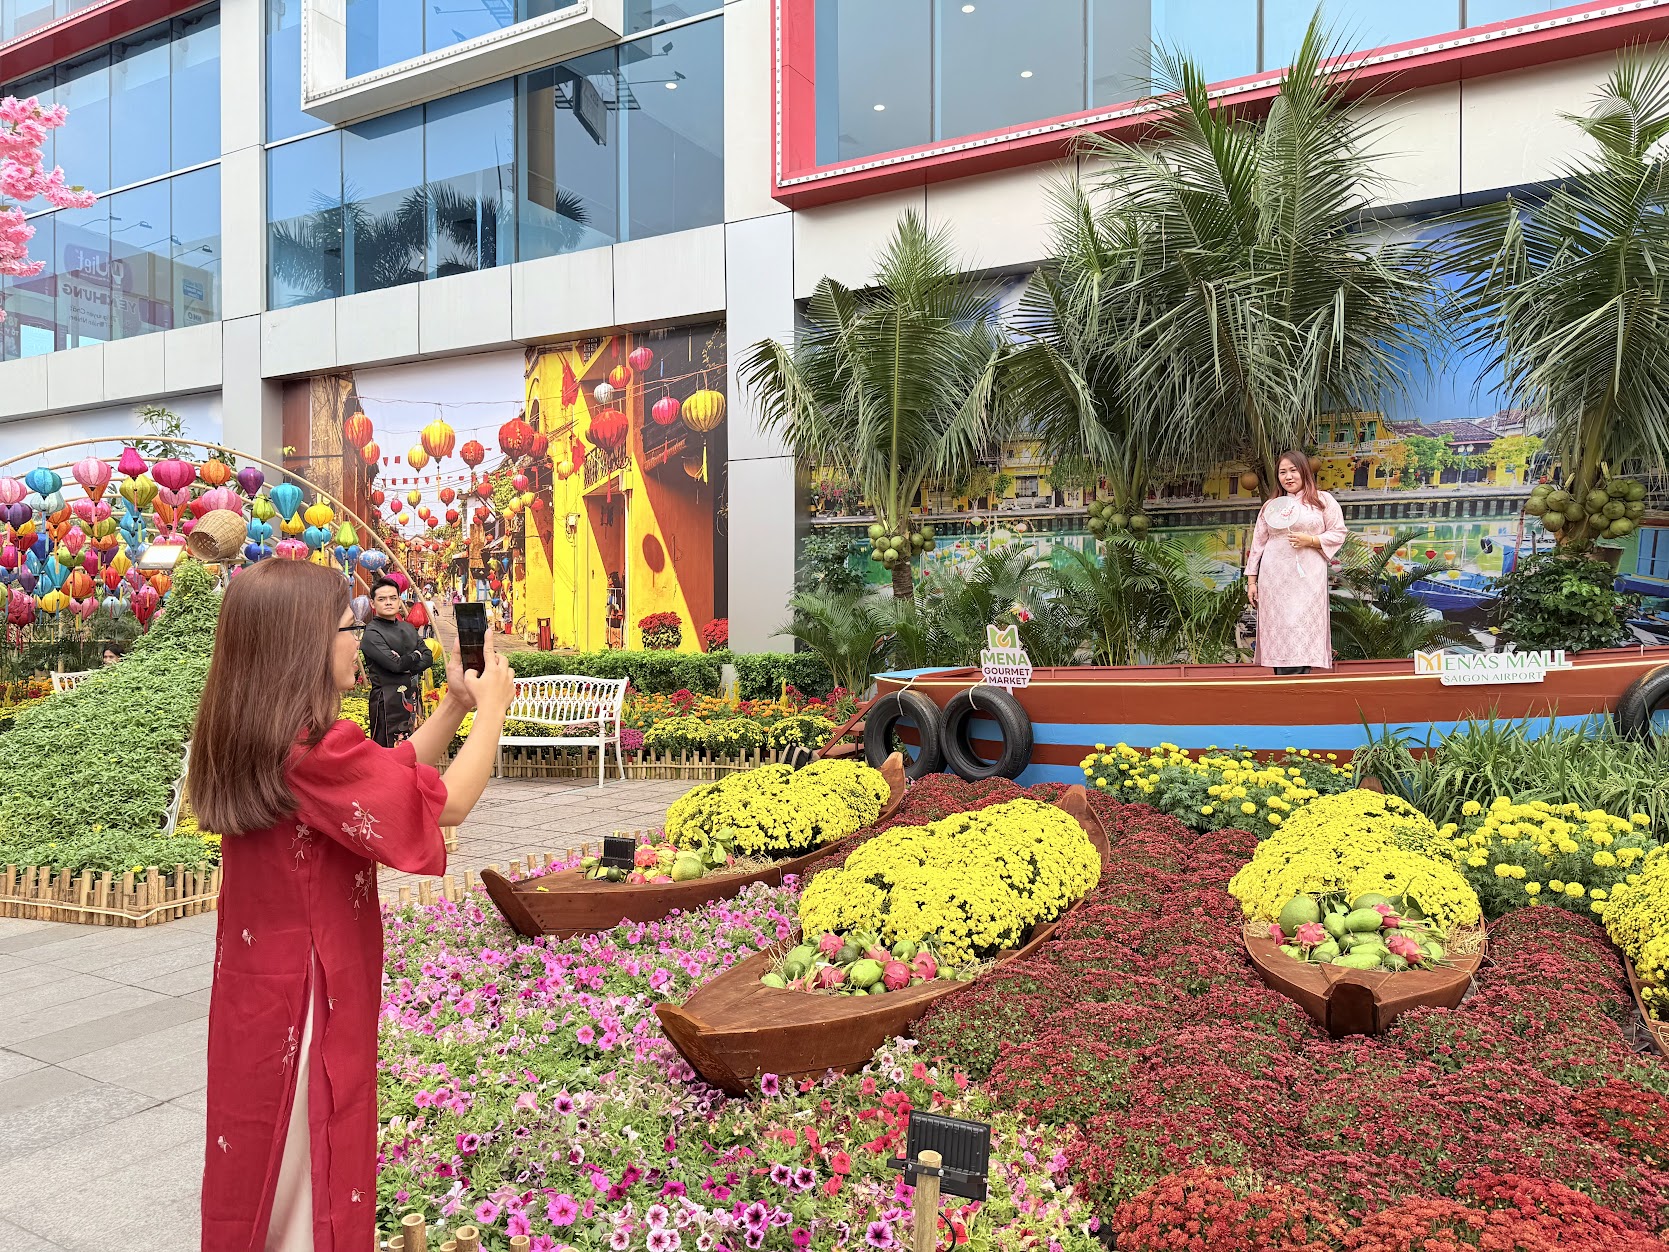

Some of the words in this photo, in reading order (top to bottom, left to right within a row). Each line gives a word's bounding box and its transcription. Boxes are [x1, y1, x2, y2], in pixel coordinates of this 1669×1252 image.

[983, 652, 1029, 666] MENA
[1417, 653, 1499, 671] MENAS
[1506, 653, 1570, 669] MALL
[984, 667, 1030, 676] GOURMET
[1444, 673, 1489, 683] SAIGON
[1492, 671, 1543, 681] AIRPORT
[988, 676, 1027, 685] MARKET
